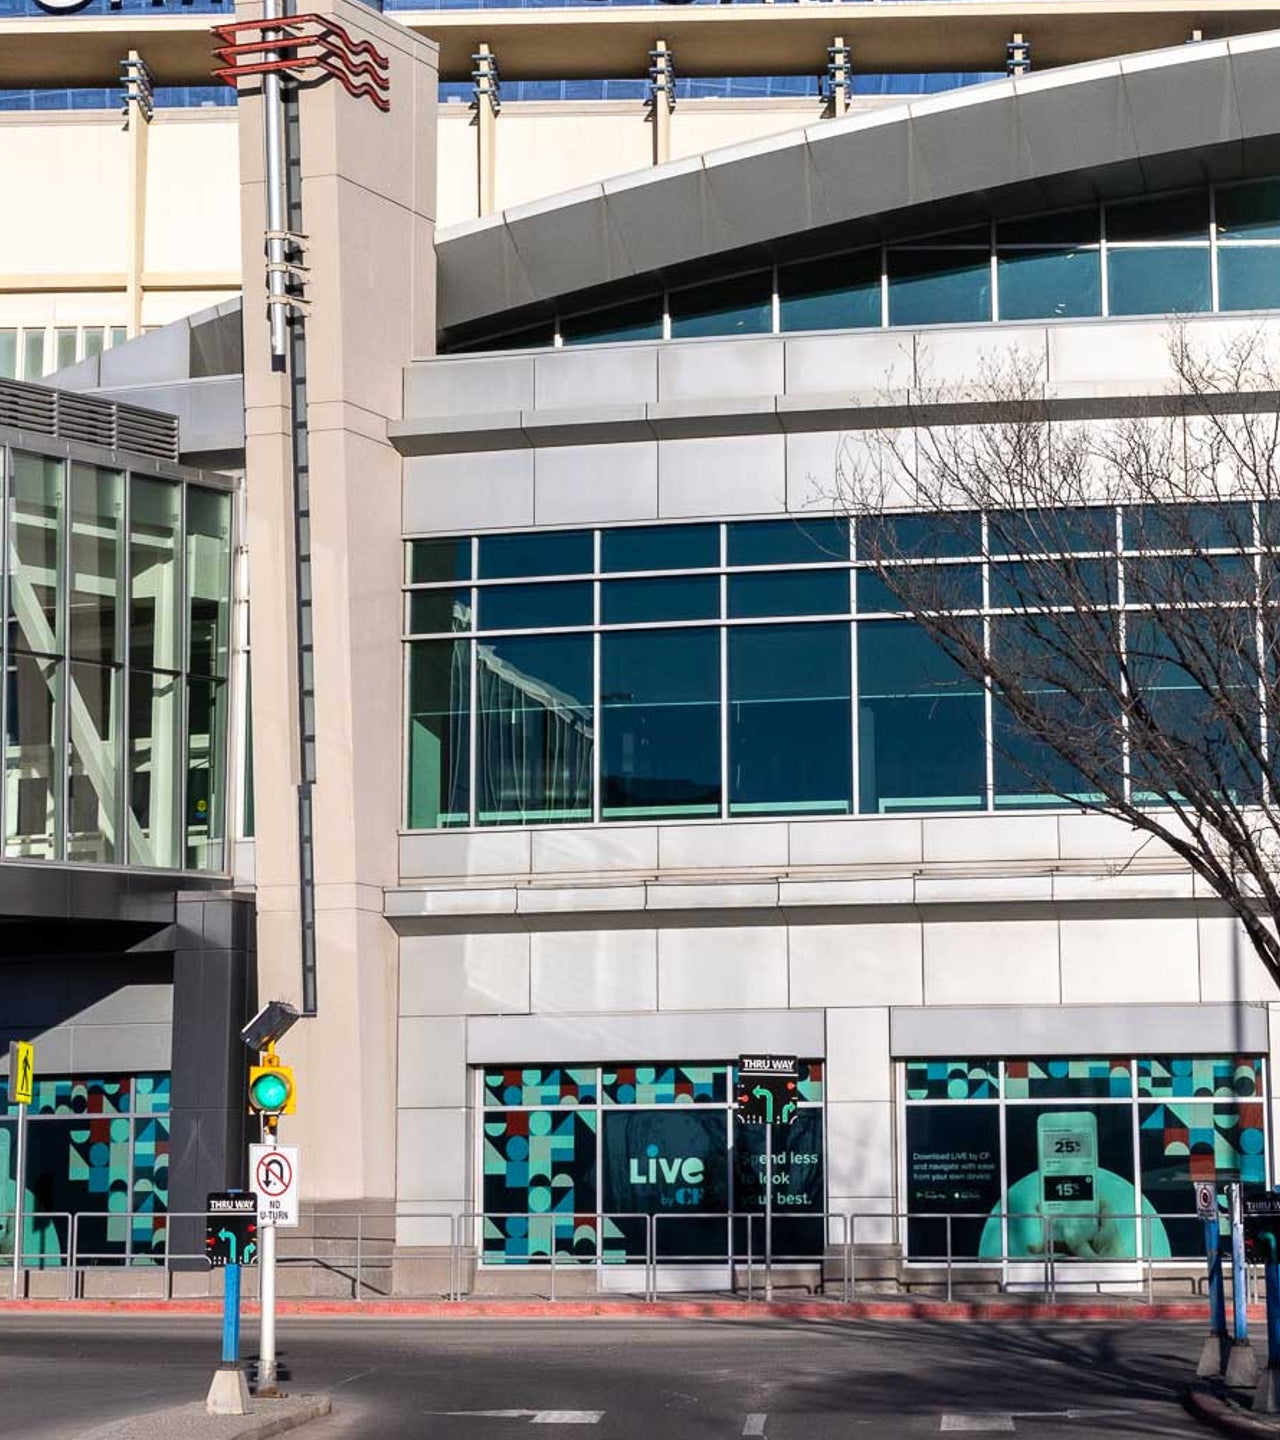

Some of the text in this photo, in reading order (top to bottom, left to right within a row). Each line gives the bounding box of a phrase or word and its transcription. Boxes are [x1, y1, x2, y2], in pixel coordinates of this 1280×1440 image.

[743, 1059, 795, 1070] THRU WAY
[790, 1151, 818, 1165] less
[777, 1191, 813, 1205] best.
[210, 1200, 255, 1209] THRU WAY
[269, 1200, 281, 1209] NO
[1246, 1201, 1271, 1210] THRU
[260, 1210, 289, 1220] U-TURN
